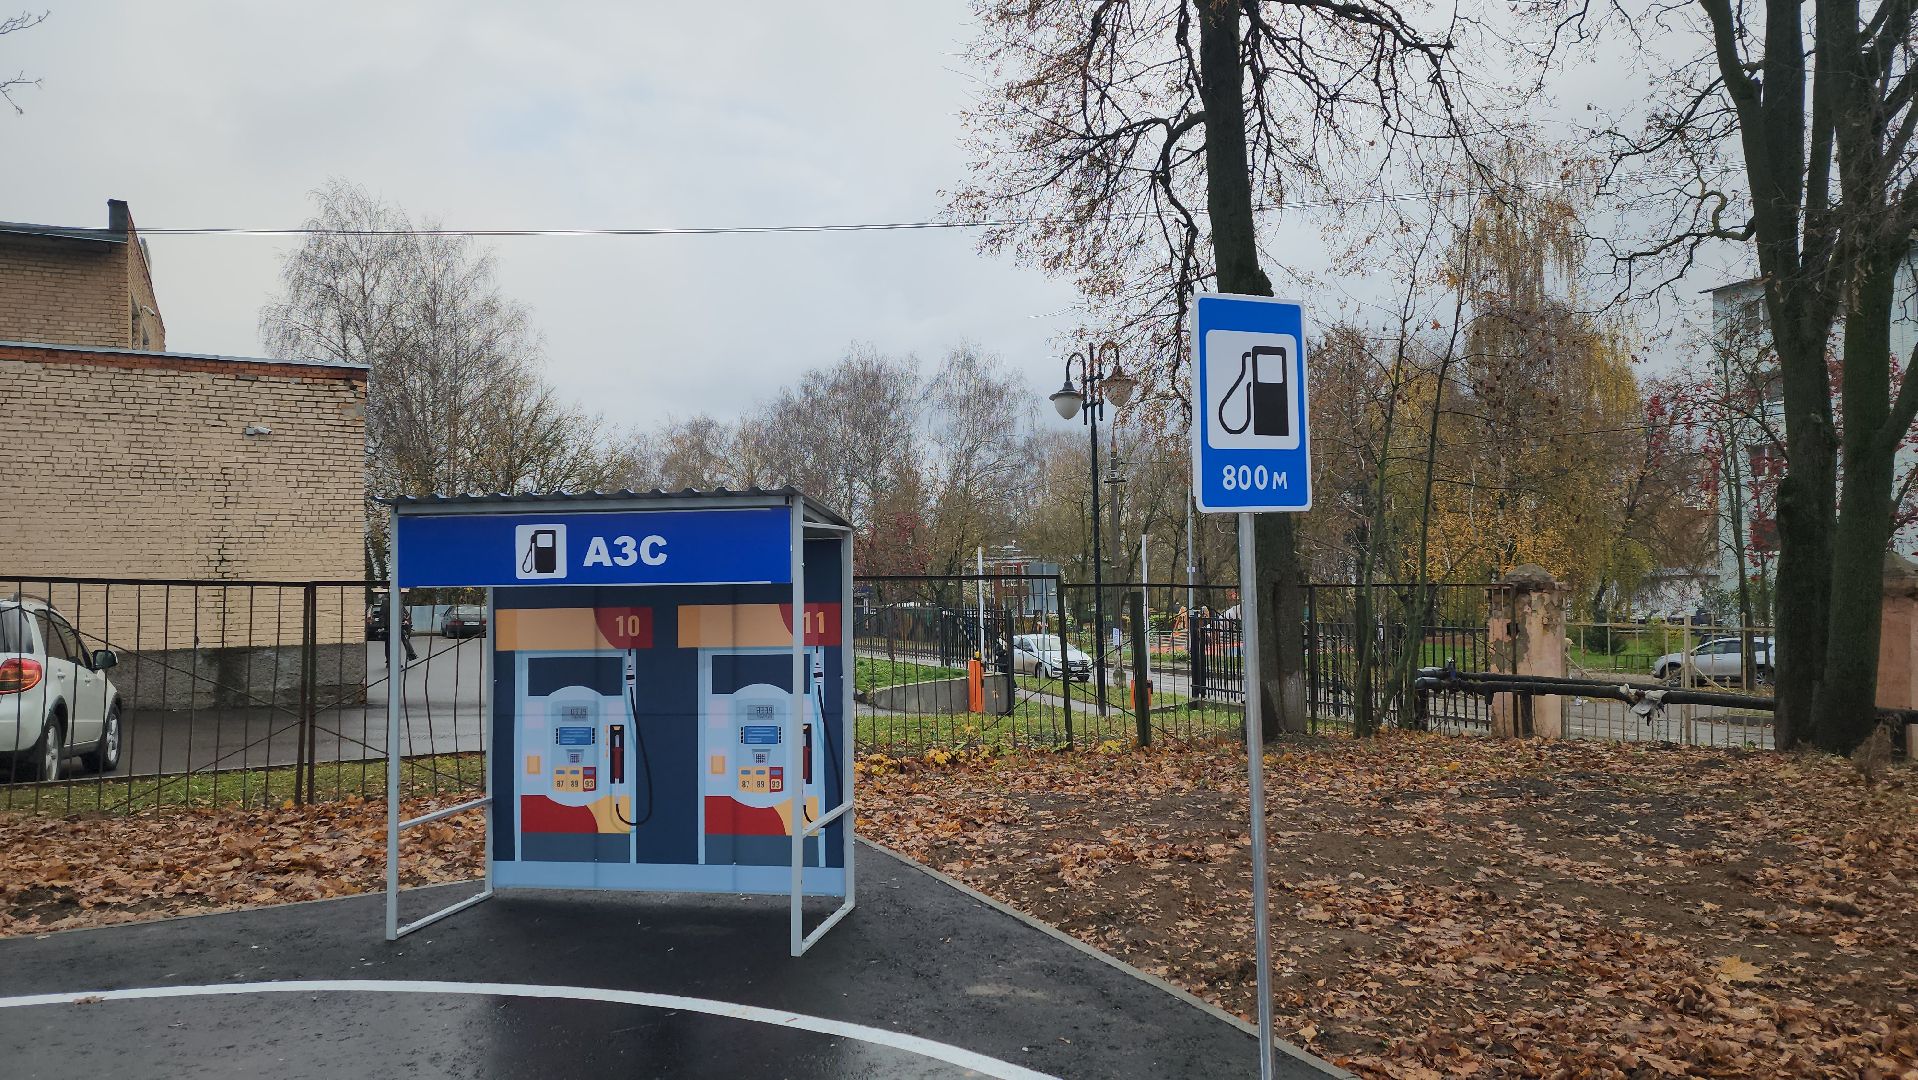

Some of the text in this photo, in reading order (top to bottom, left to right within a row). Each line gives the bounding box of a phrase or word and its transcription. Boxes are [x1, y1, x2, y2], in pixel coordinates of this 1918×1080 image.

[583, 535, 668, 567] АЗС
[615, 615, 640, 637] 10
[803, 611, 825, 634] 11
[584, 780, 594, 788] 93
[771, 780, 781, 789] 93
